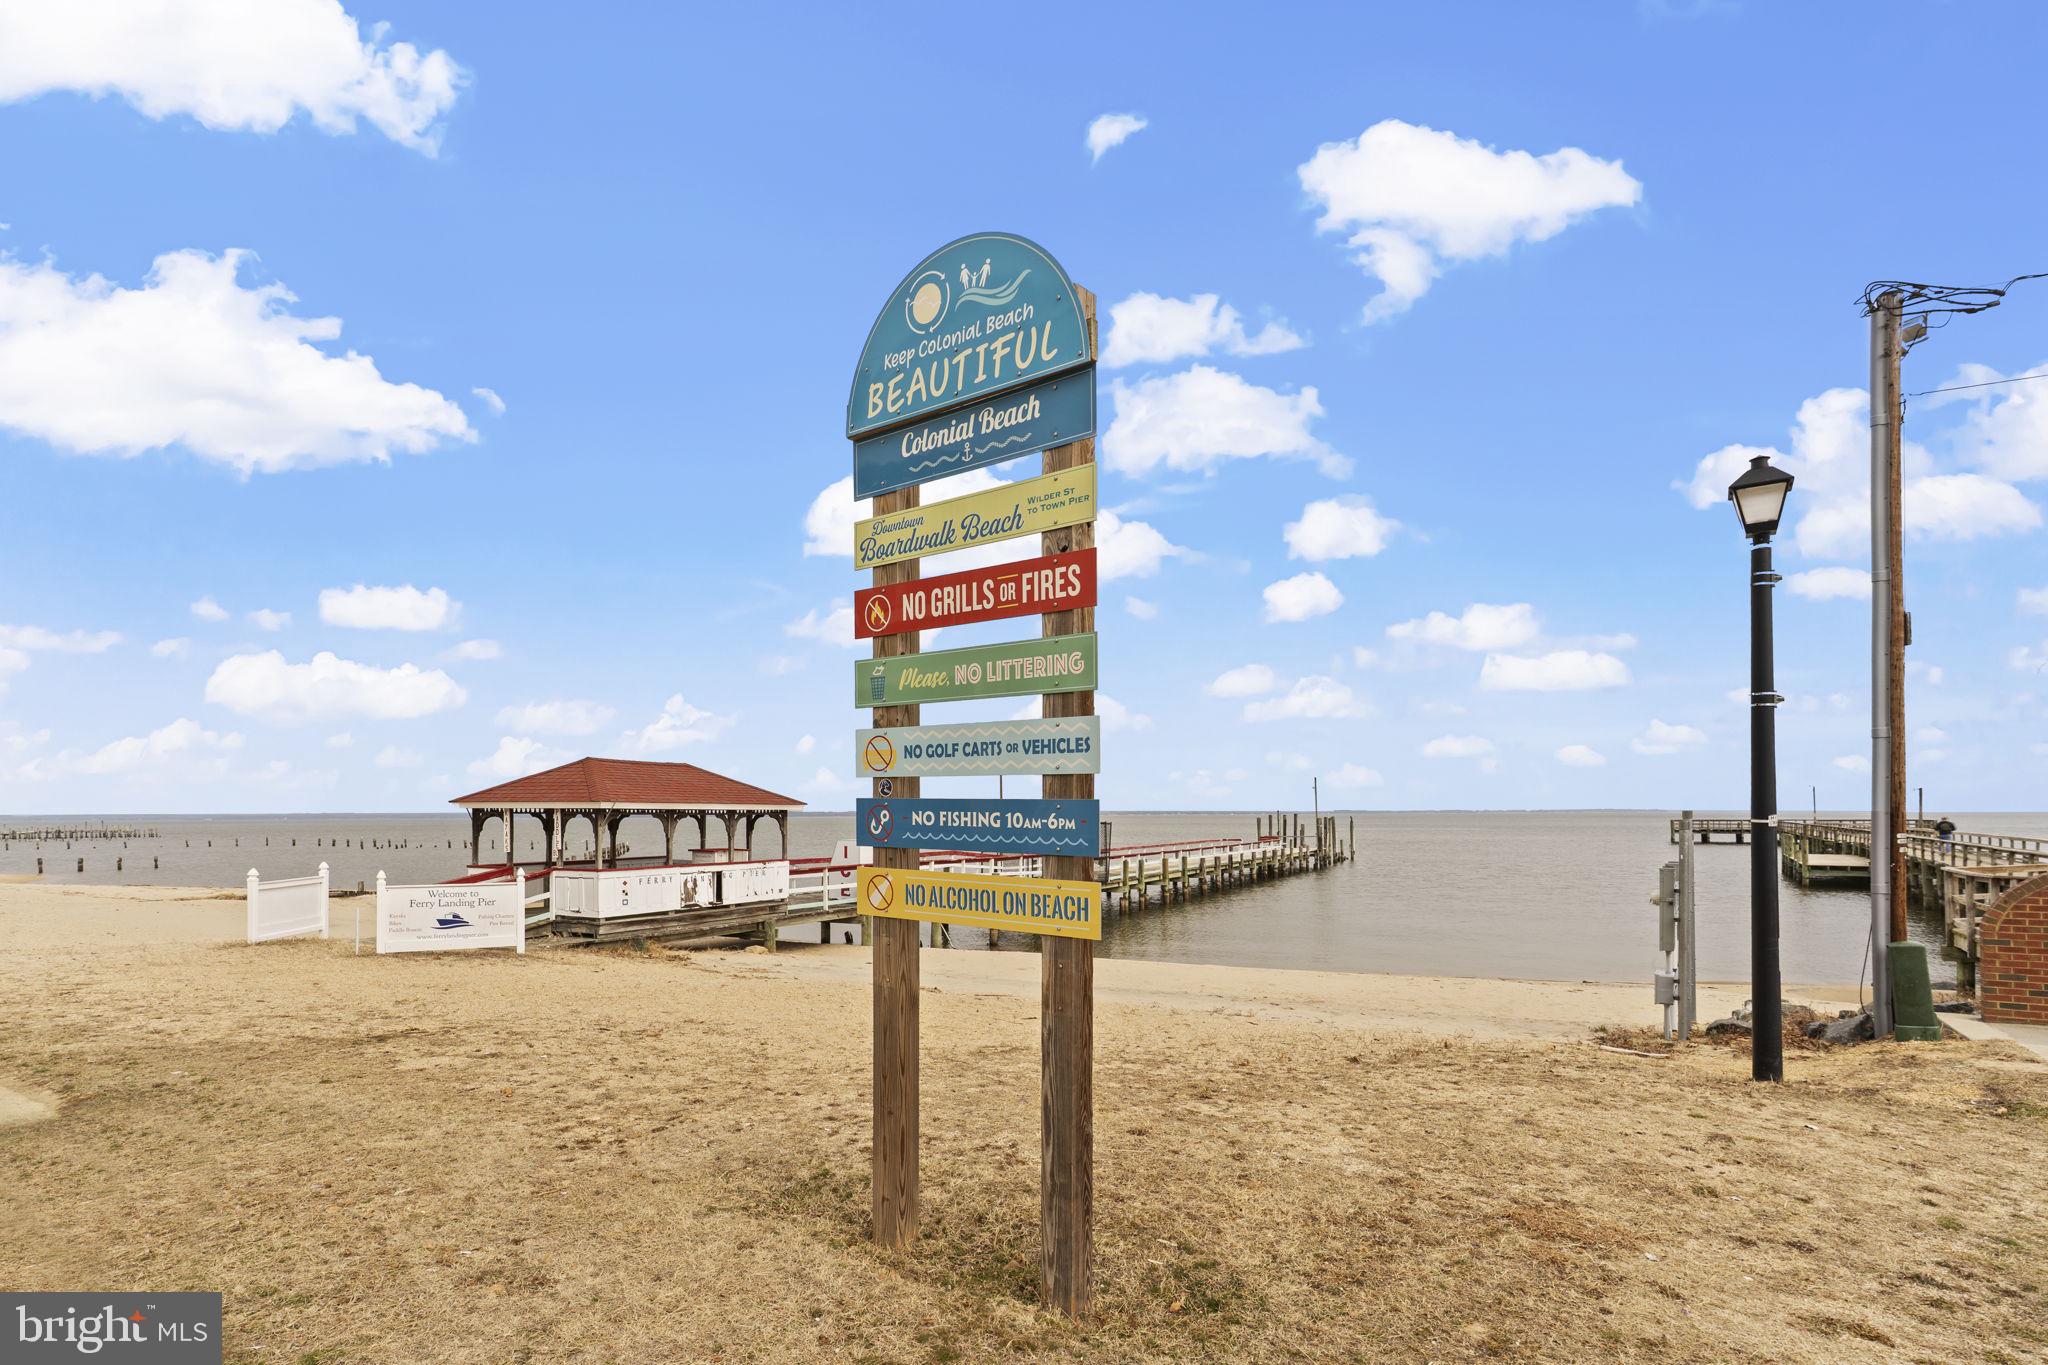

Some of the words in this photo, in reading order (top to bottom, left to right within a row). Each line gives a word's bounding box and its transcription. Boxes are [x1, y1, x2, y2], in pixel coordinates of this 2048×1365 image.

[884, 349, 915, 370] Keep
[919, 321, 981, 356] Colonial
[987, 303, 1034, 333] Beach
[867, 320, 1057, 419] BEAUTIFUL
[901, 419, 974, 457] Colonial
[979, 394, 1040, 434] Beach
[1027, 490, 1060, 505] WILDER
[1040, 500, 1066, 512] TOWN
[1068, 494, 1090, 506] PIER
[860, 520, 957, 563] Boardwalk
[961, 504, 1024, 542] Beach
[871, 516, 924, 537] Downtown
[902, 591, 926, 622] NO
[931, 579, 994, 617] GRILLS
[1000, 582, 1016, 601] OR
[1022, 564, 1081, 604] FIRES
[899, 667, 950, 691] Please,
[955, 662, 981, 685] NO
[986, 651, 1085, 682] LITTERING
[904, 744, 922, 759] NO
[926, 742, 959, 758] GOLF
[963, 740, 1002, 757] CARTS
[1006, 743, 1019, 753] OR
[1022, 736, 1091, 755] VEHICLES
[912, 811, 935, 826] NO
[940, 811, 1001, 828] FISHING
[410, 899, 435, 909] Ferry
[438, 899, 475, 908] Landing
[478, 898, 496, 906] Pier
[427, 890, 467, 898] Welcome
[470, 890, 479, 898] to
[905, 883, 926, 907] NO
[928, 885, 999, 914] ALCOHOL
[1003, 892, 1026, 916] ON
[1031, 894, 1089, 922] BEACH
